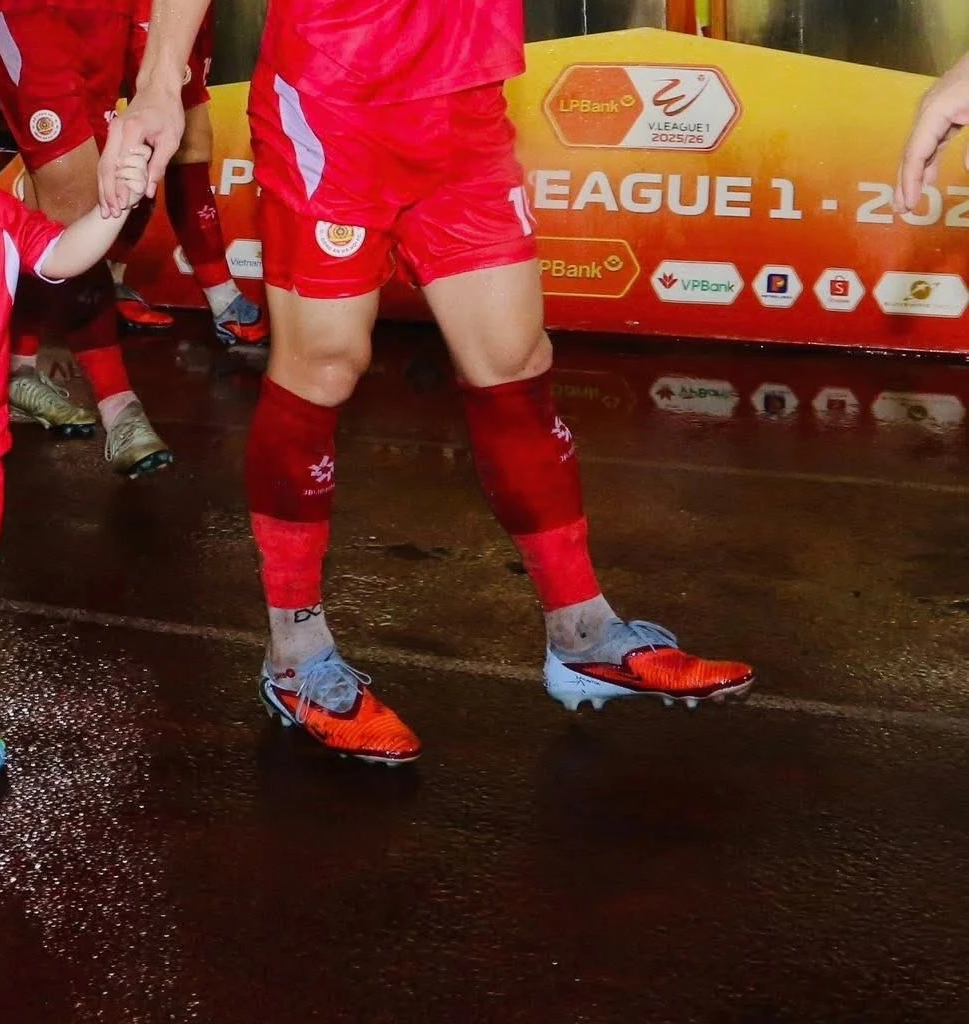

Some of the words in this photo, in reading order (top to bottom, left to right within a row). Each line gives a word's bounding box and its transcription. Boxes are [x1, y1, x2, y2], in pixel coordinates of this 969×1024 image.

[559, 99, 619, 114] LPBank
[648, 122, 703, 133] V.LEAGUE
[705, 123, 710, 132] 1
[651, 133, 704, 144] 2025/26
[534, 170, 752, 217] EAGUE
[769, 177, 803, 220] 1
[539, 260, 603, 279] PBank
[681, 279, 735, 293] VPBank
